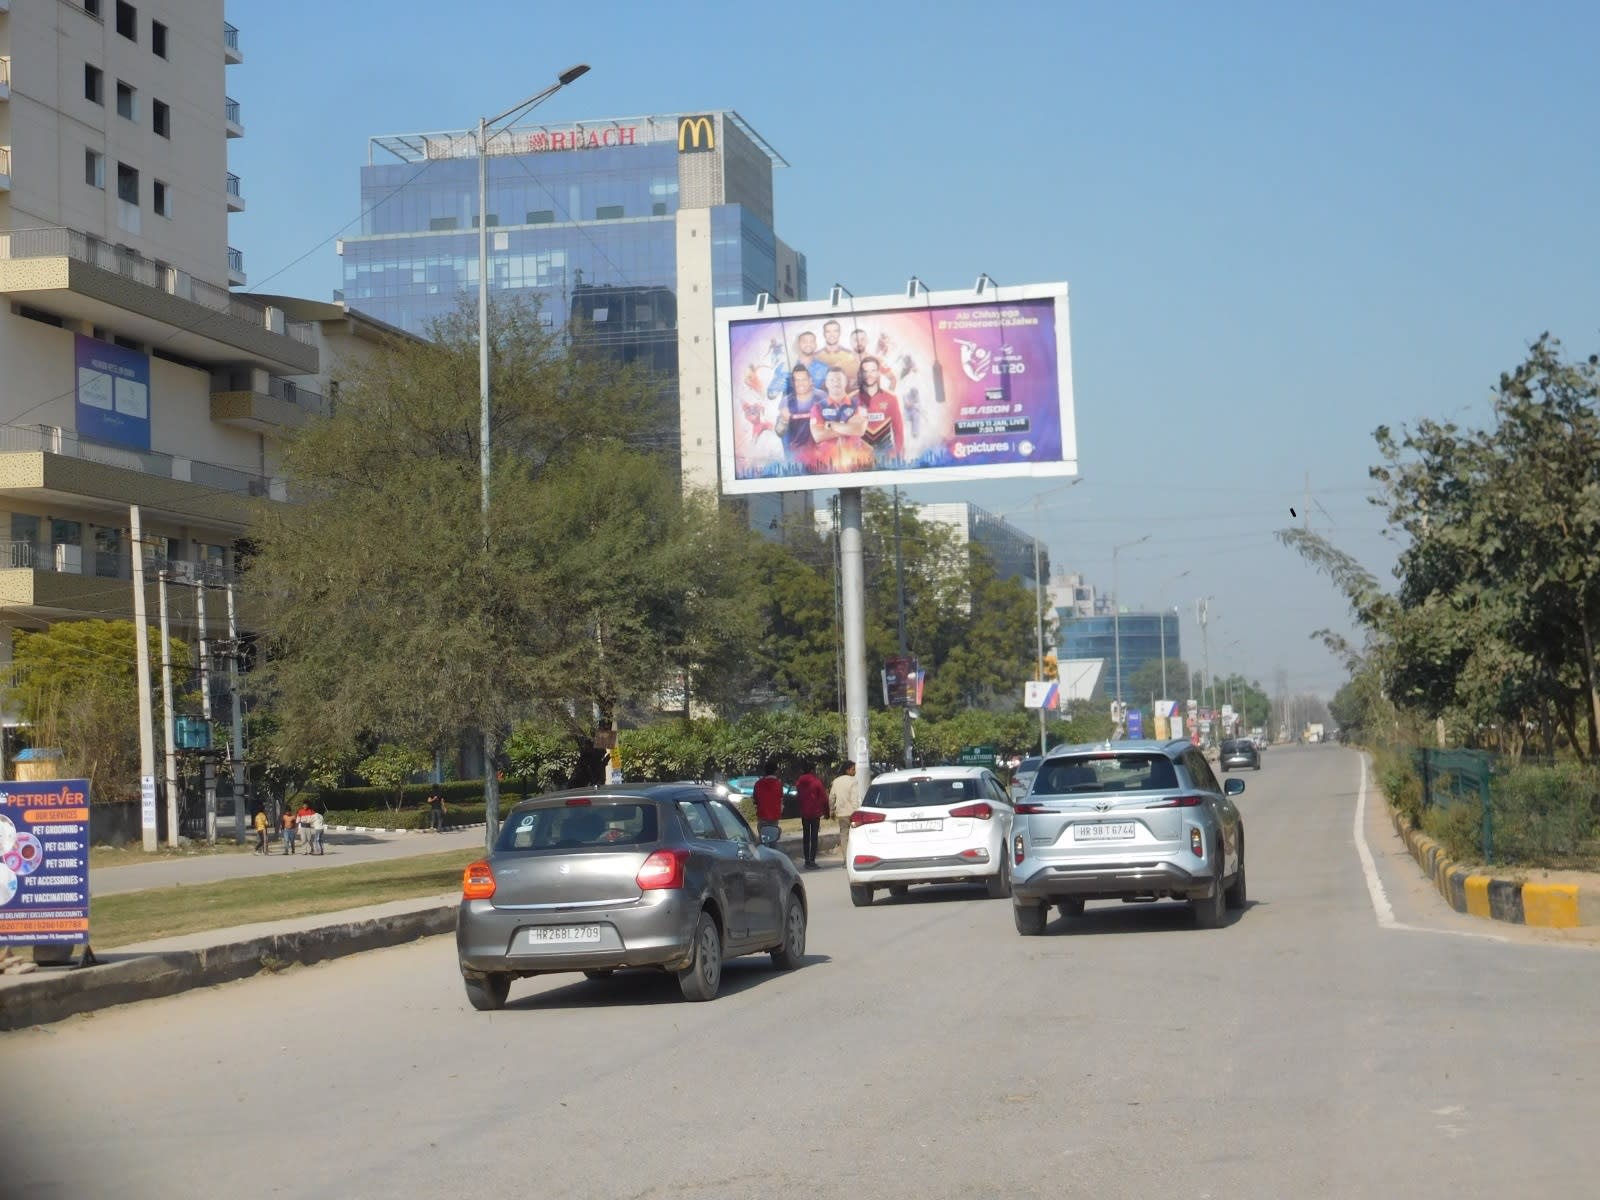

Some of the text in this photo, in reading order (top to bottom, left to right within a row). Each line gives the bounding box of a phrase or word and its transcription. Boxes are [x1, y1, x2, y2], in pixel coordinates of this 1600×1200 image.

[992, 363, 1025, 374] ILT20
[960, 405, 1010, 415] SEASON
[7, 788, 84, 806] PETRIEVER
[33, 825, 78, 834] PET GROOMING
[45, 842, 78, 851] PET CLINIC
[46, 858, 78, 868] PET STORE
[25, 876, 78, 885] PET ACCESSORIES
[22, 893, 78, 903] PET VACCINATIONS
